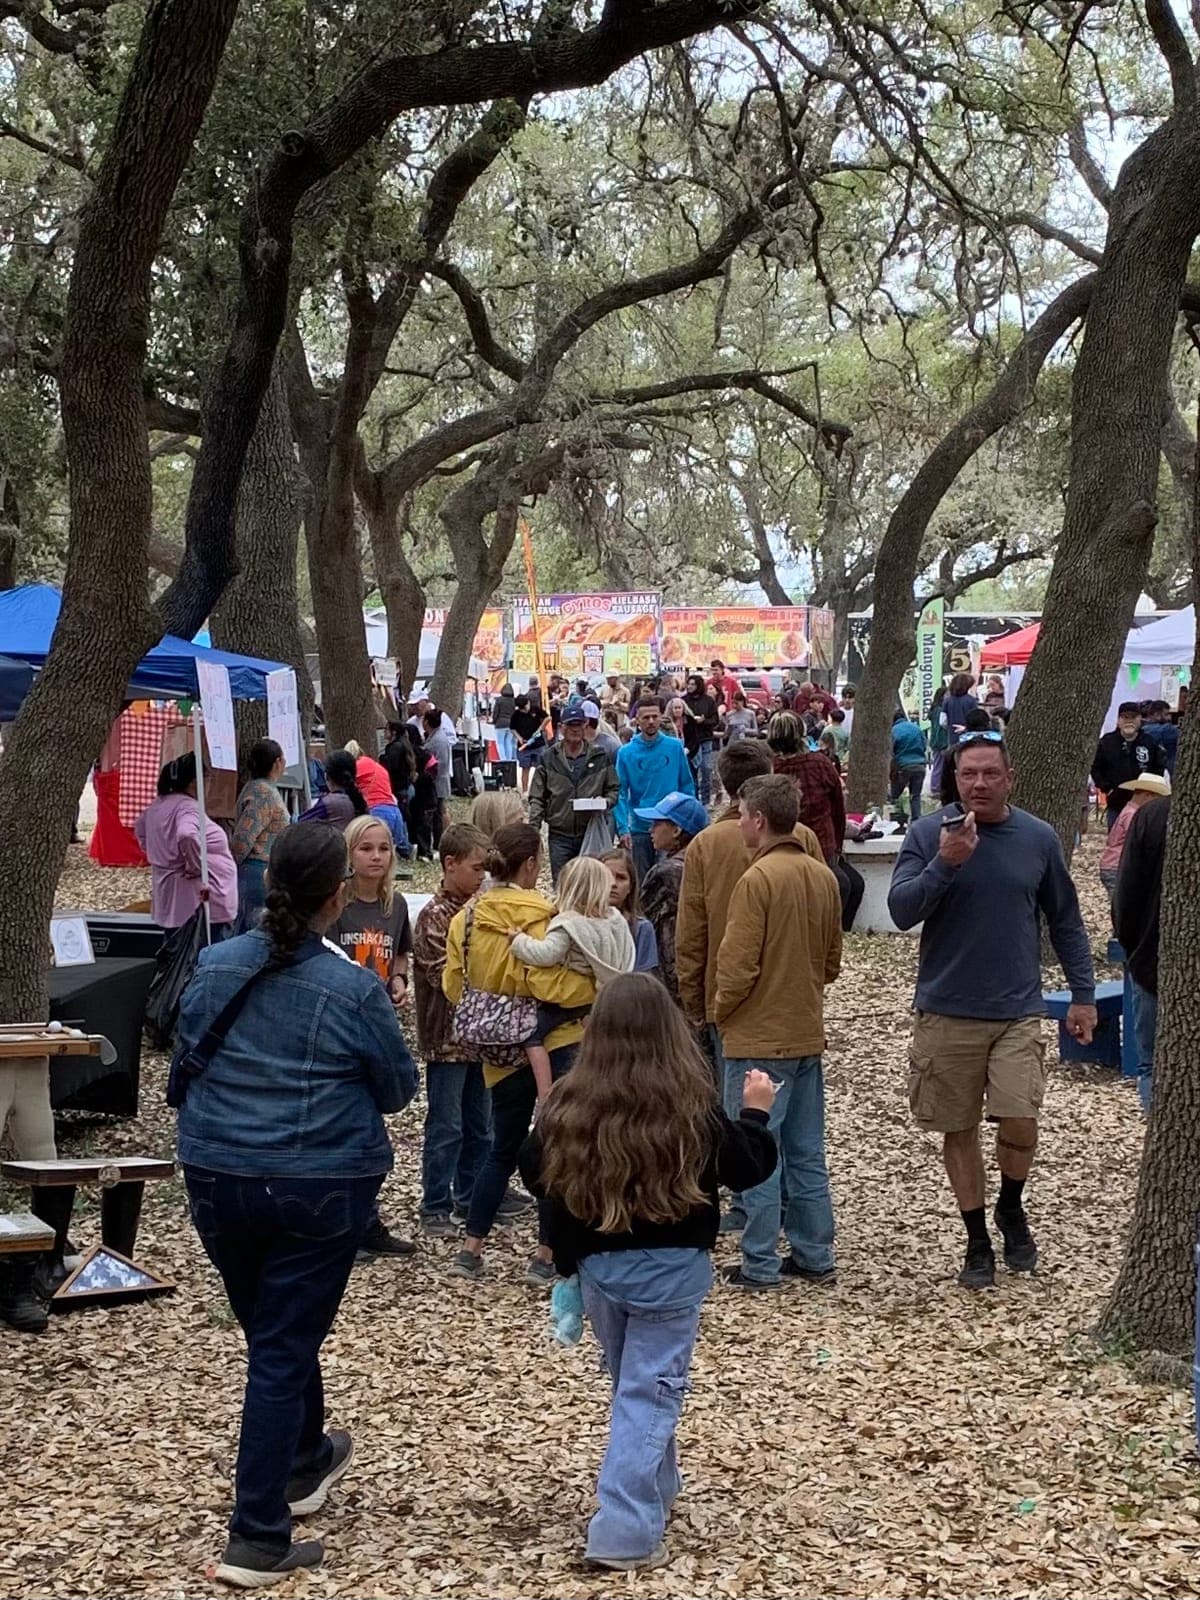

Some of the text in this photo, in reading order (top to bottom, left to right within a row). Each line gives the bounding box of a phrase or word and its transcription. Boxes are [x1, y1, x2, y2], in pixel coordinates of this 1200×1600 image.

[611, 595, 657, 605] KIELBASA
[519, 606, 561, 615] SASAGE
[562, 597, 612, 615] GYROS
[612, 604, 655, 615] SAUSAGE
[920, 633, 936, 722] Mangonadas
